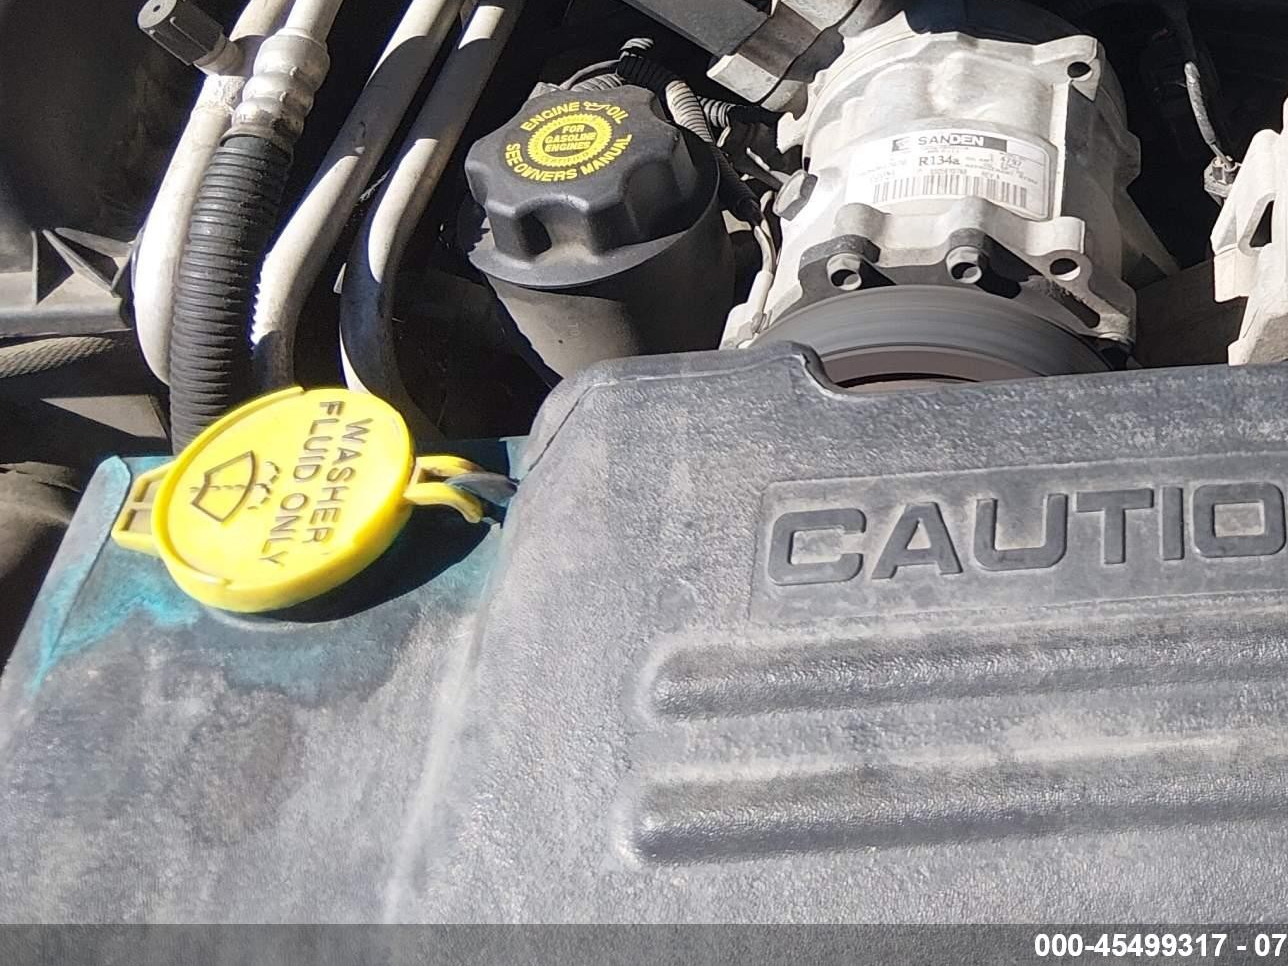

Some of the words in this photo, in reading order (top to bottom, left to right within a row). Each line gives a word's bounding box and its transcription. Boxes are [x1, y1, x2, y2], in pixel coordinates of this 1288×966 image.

[520, 101, 581, 131] ENGINE
[606, 105, 630, 125] OIL
[545, 132, 597, 144] GASOLINE
[562, 125, 585, 134] FOR
[917, 133, 984, 147] SANDEN
[505, 143, 523, 167] SEE
[544, 141, 592, 153] ENGINES
[580, 134, 633, 176] MANUAL
[918, 155, 961, 167] R134a
[513, 163, 578, 182] OWNERS
[292, 400, 345, 481] FLUID
[302, 417, 374, 544] WASHER
[258, 492, 309, 567] ONLY
